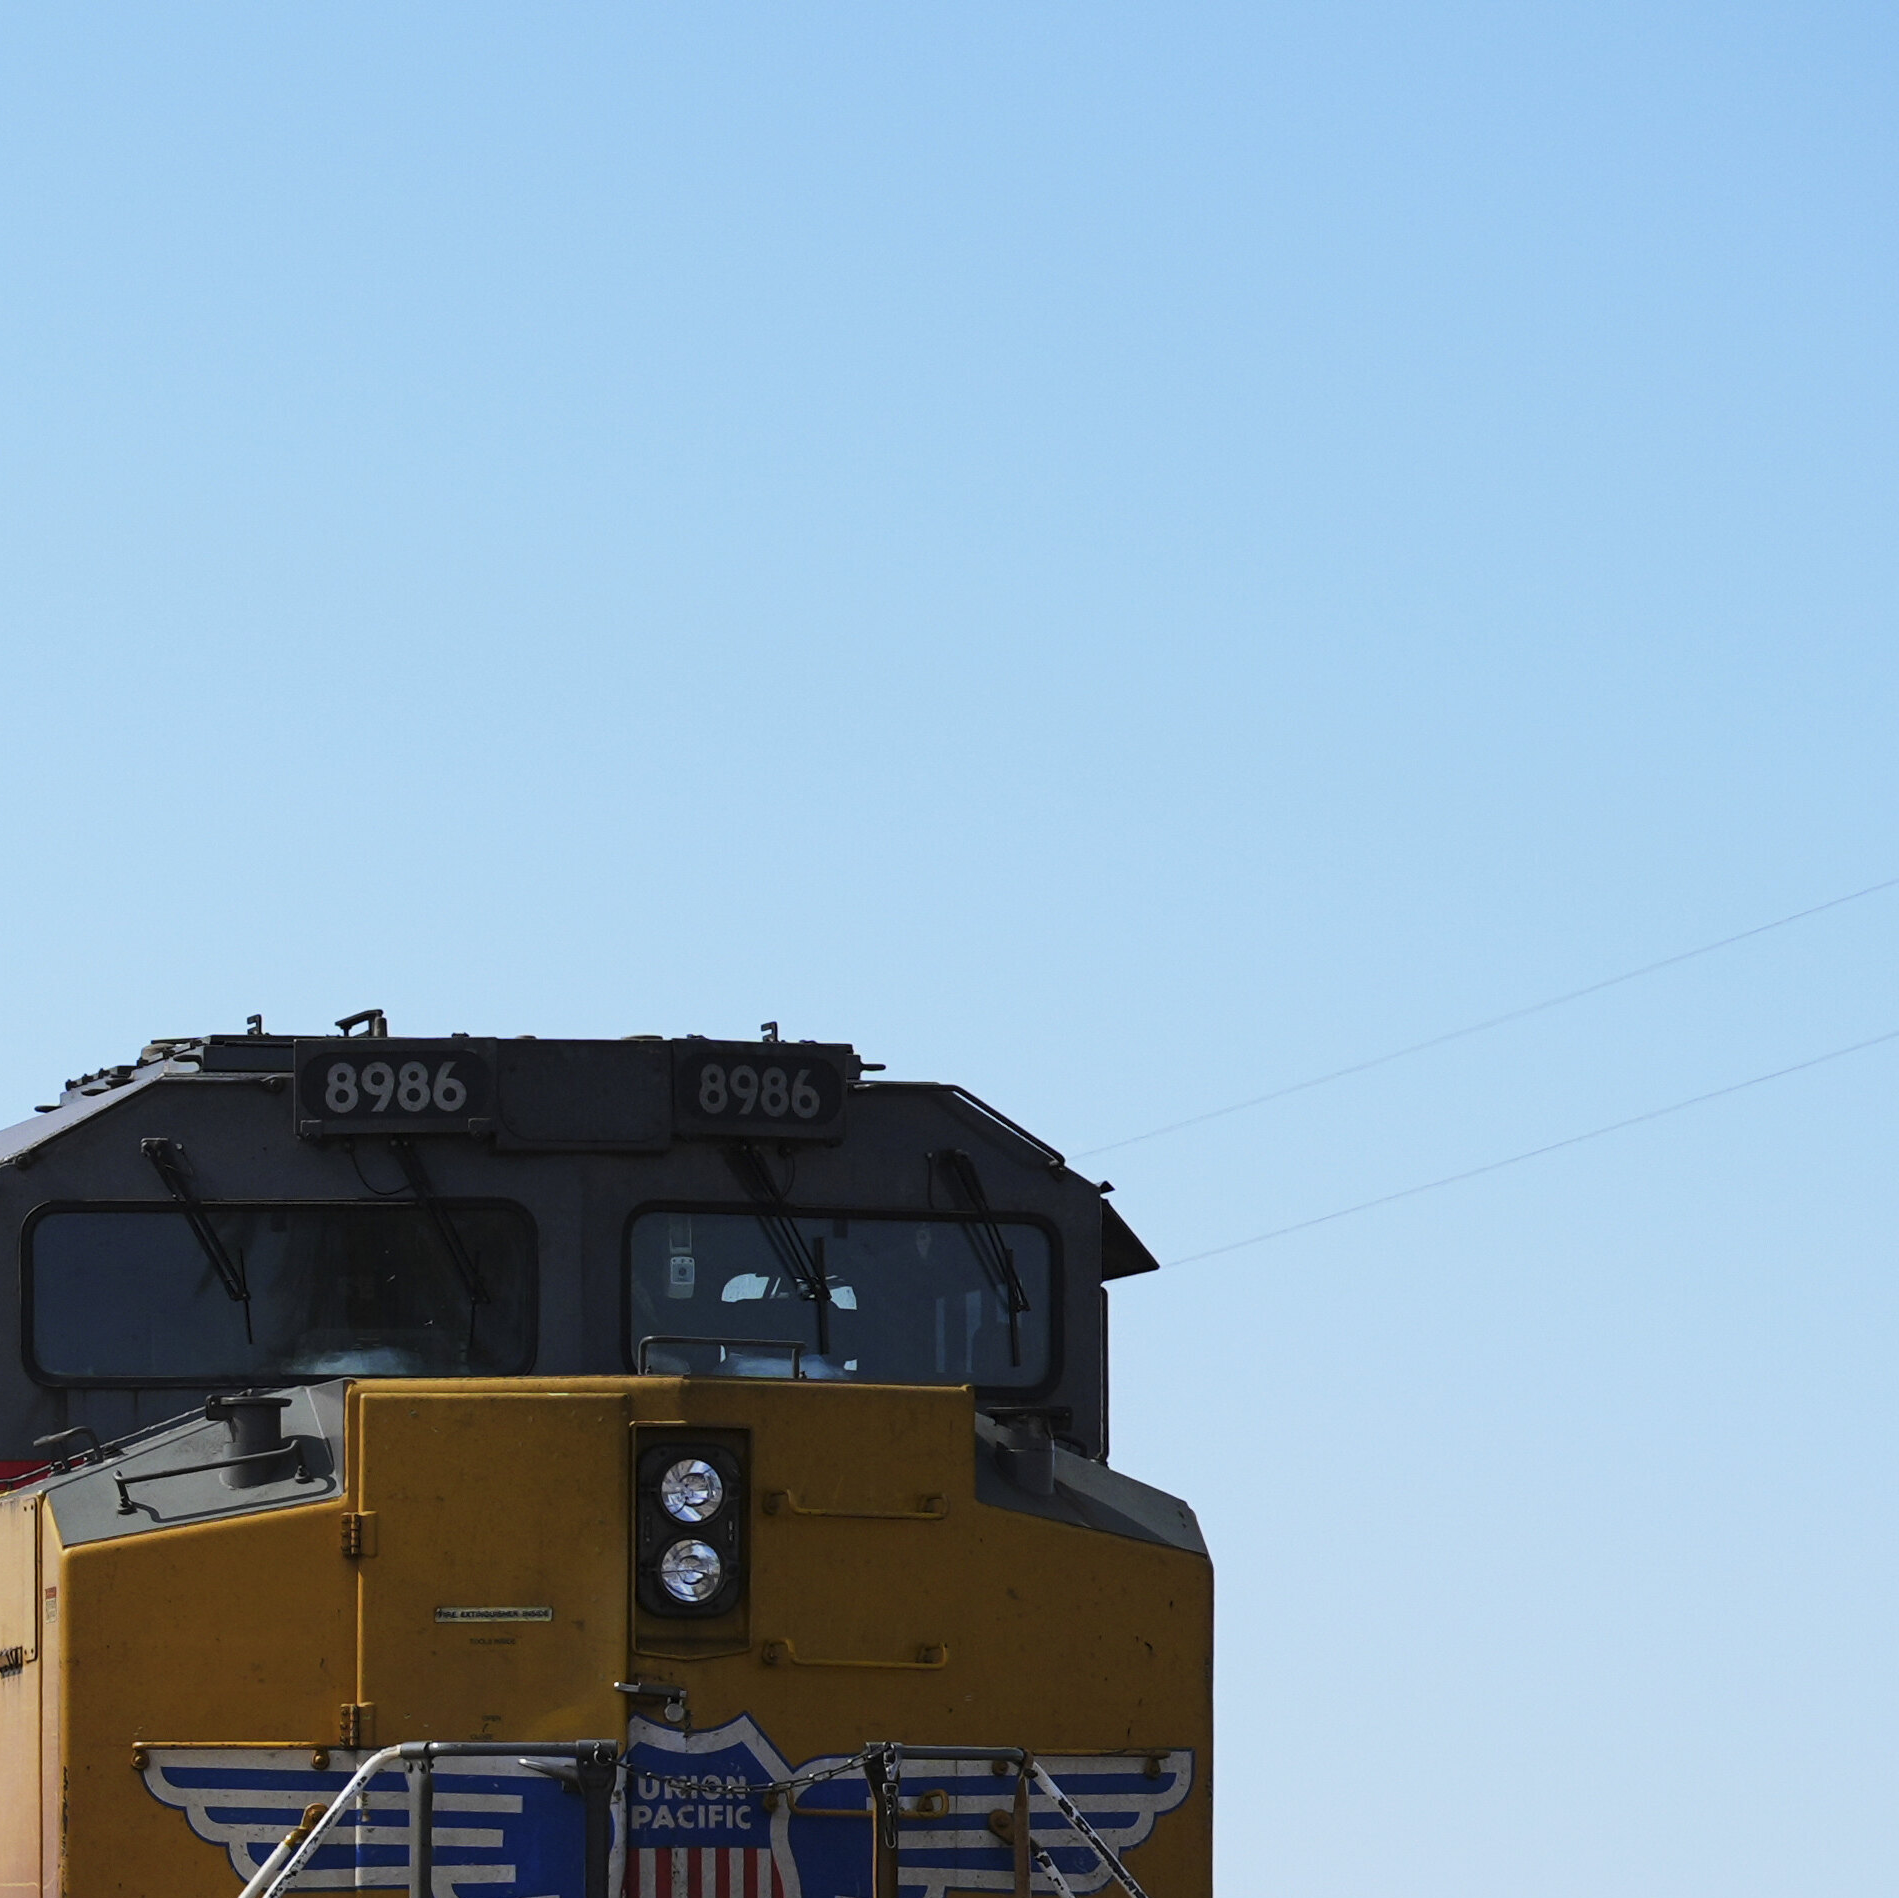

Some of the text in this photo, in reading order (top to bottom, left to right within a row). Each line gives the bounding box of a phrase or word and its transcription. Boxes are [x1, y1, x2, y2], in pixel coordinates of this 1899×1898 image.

[324, 1060, 468, 1114] 8986
[698, 1063, 821, 1119] 8986
[460, 1610, 519, 1618] EXTINGUISHER
[522, 1609, 549, 1618] INSIDE
[637, 1774, 748, 1802] UNION
[630, 1804, 753, 1831] PACIFIC
